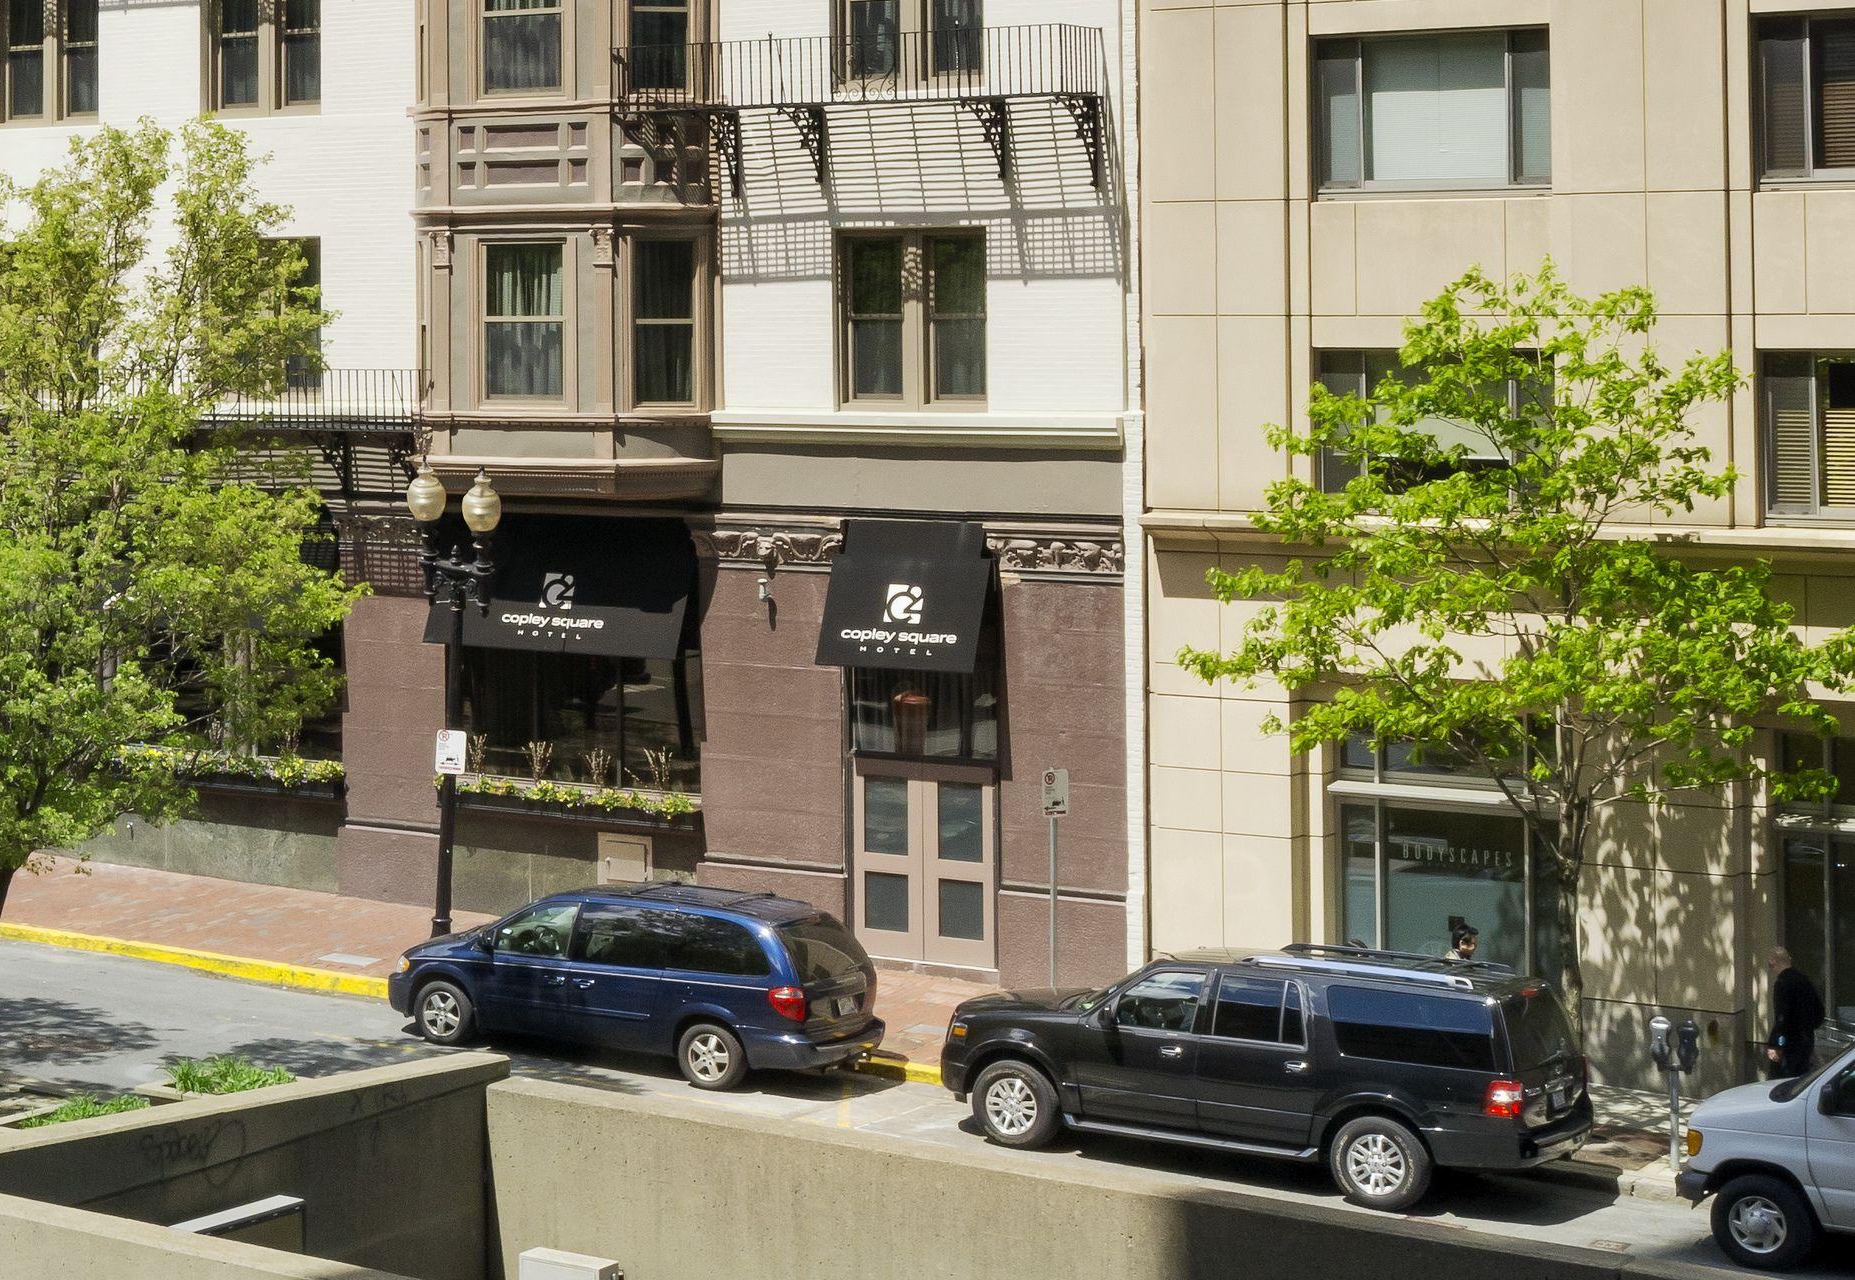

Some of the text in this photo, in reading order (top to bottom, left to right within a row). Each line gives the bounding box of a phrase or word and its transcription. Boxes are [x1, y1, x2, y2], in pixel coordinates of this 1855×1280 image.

[502, 613, 604, 629] copley square
[517, 630, 581, 640] HOTEL
[841, 628, 957, 644] copley square
[859, 646, 932, 656] HOTEL
[1403, 843, 1512, 867] BODYSCAPES
